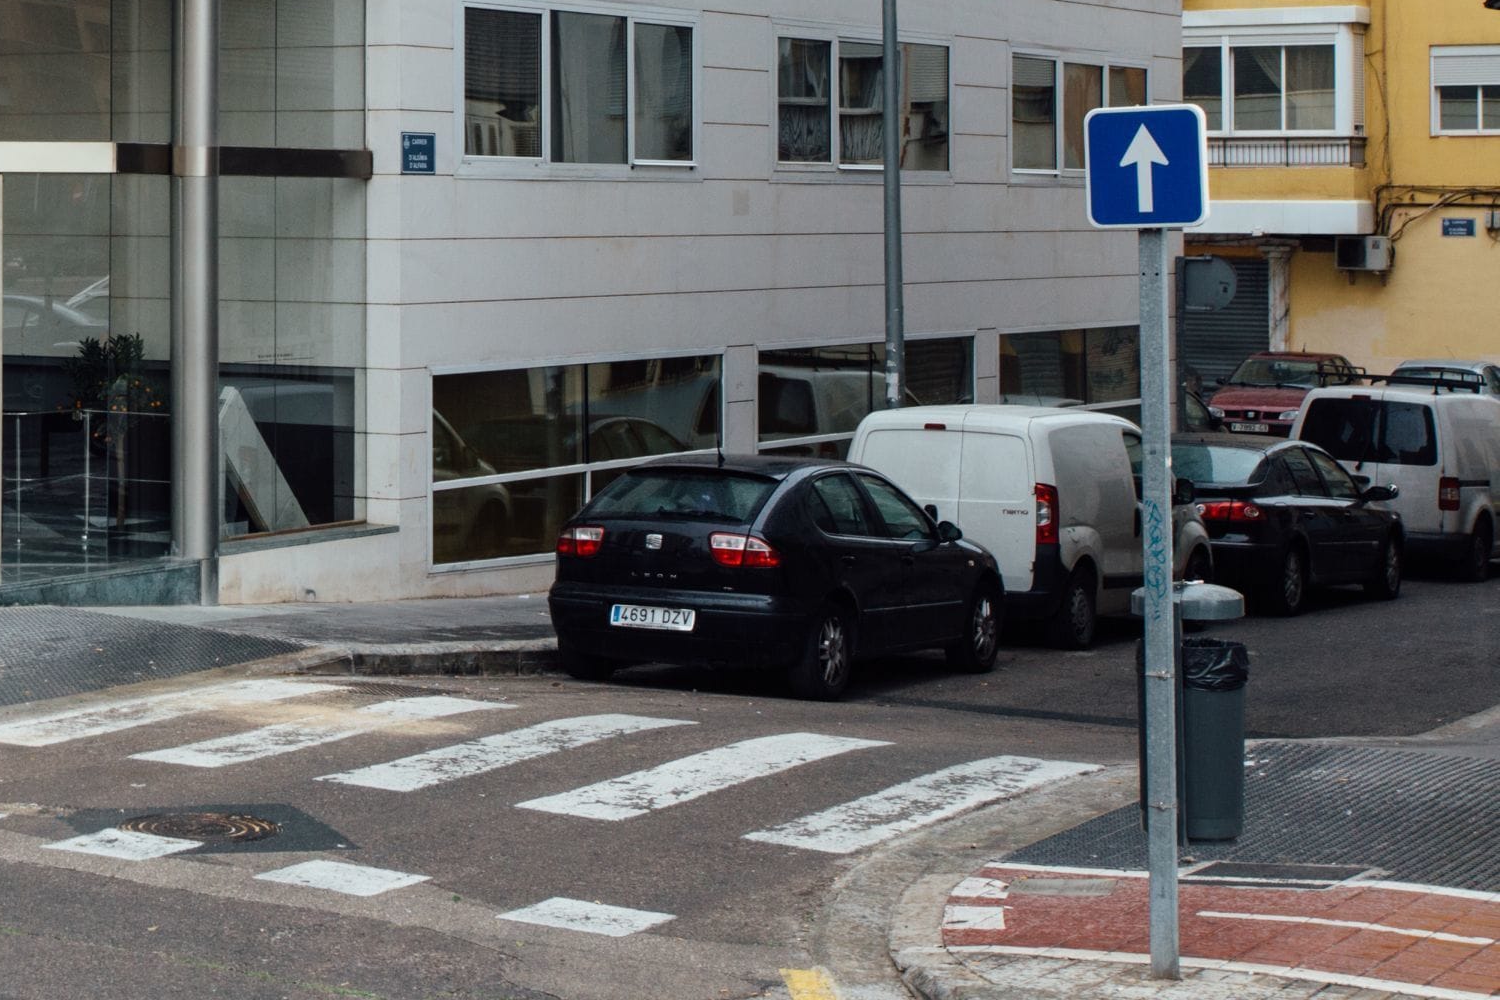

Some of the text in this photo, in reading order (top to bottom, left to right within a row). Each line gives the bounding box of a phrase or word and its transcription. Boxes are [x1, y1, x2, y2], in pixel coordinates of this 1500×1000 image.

[1002, 508, 1029, 516] nemo
[621, 607, 691, 625] 4691 DZV
